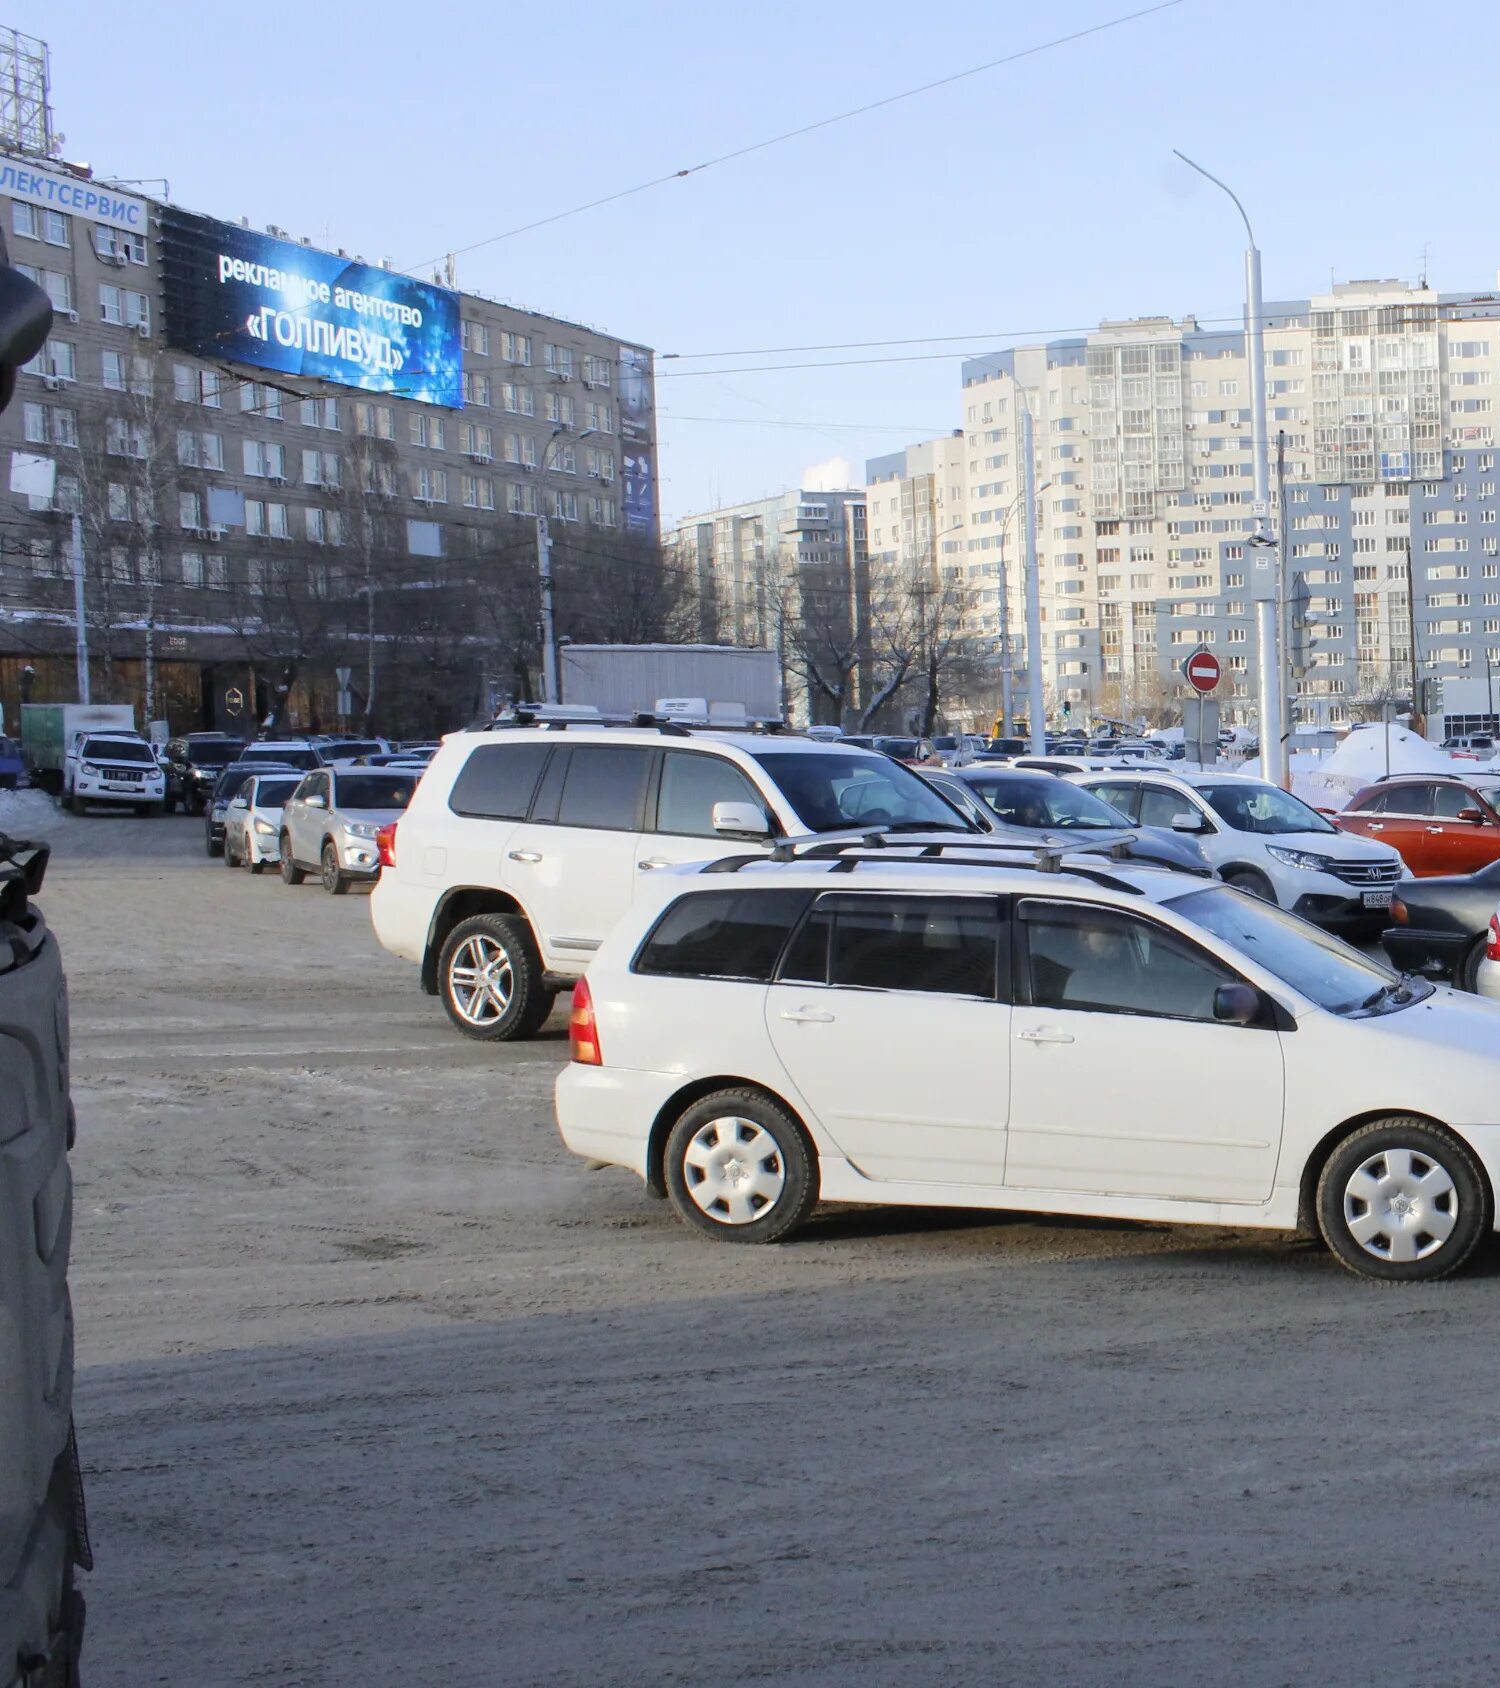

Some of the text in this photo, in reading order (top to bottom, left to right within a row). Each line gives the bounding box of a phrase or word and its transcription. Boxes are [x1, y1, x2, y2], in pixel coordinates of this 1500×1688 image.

[218, 255, 423, 328] рекламное агентство
[245, 307, 404, 376] «ГОЛЛИВУД»
